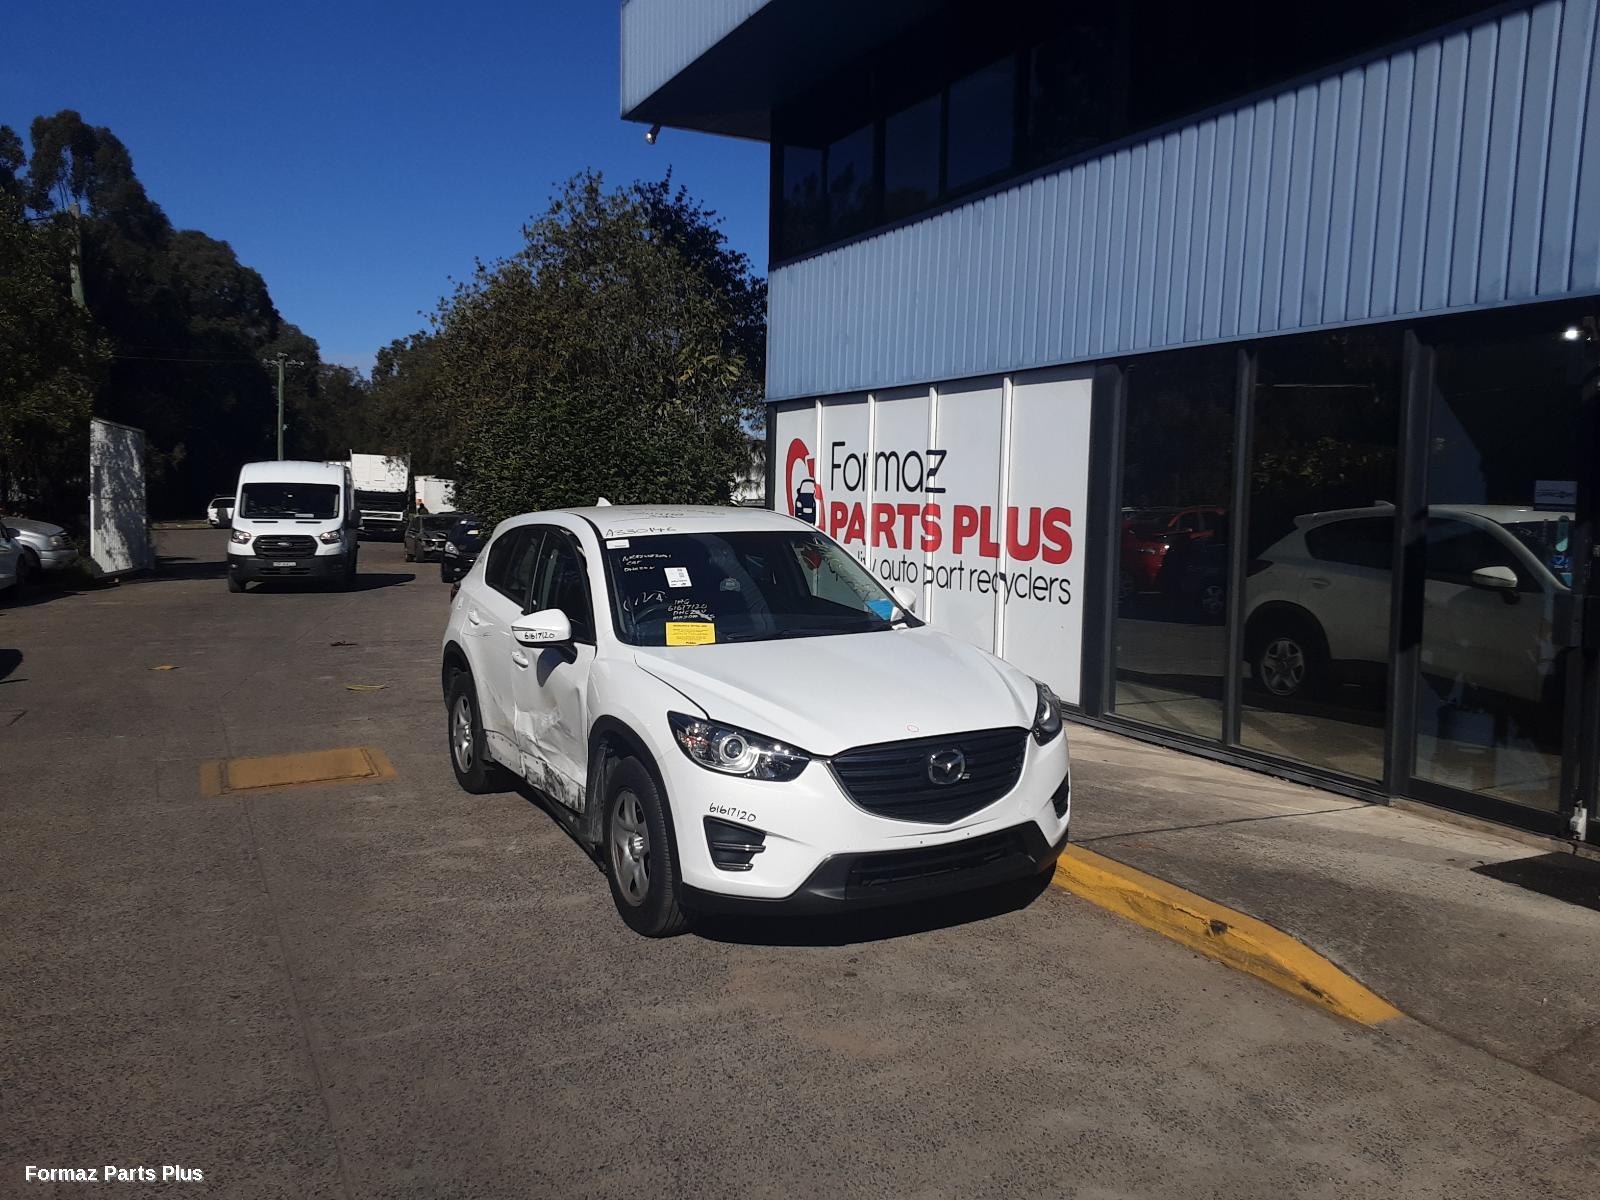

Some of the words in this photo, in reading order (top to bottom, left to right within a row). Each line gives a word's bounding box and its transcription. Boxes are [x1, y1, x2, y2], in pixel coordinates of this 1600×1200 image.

[830, 441, 947, 494] Formaz
[830, 501, 943, 553] PARTS
[952, 504, 1073, 565] PLUS
[880, 554, 918, 584] auto
[923, 559, 965, 592] part
[970, 566, 1072, 605] recyclers
[709, 802, 757, 822] 61617120
